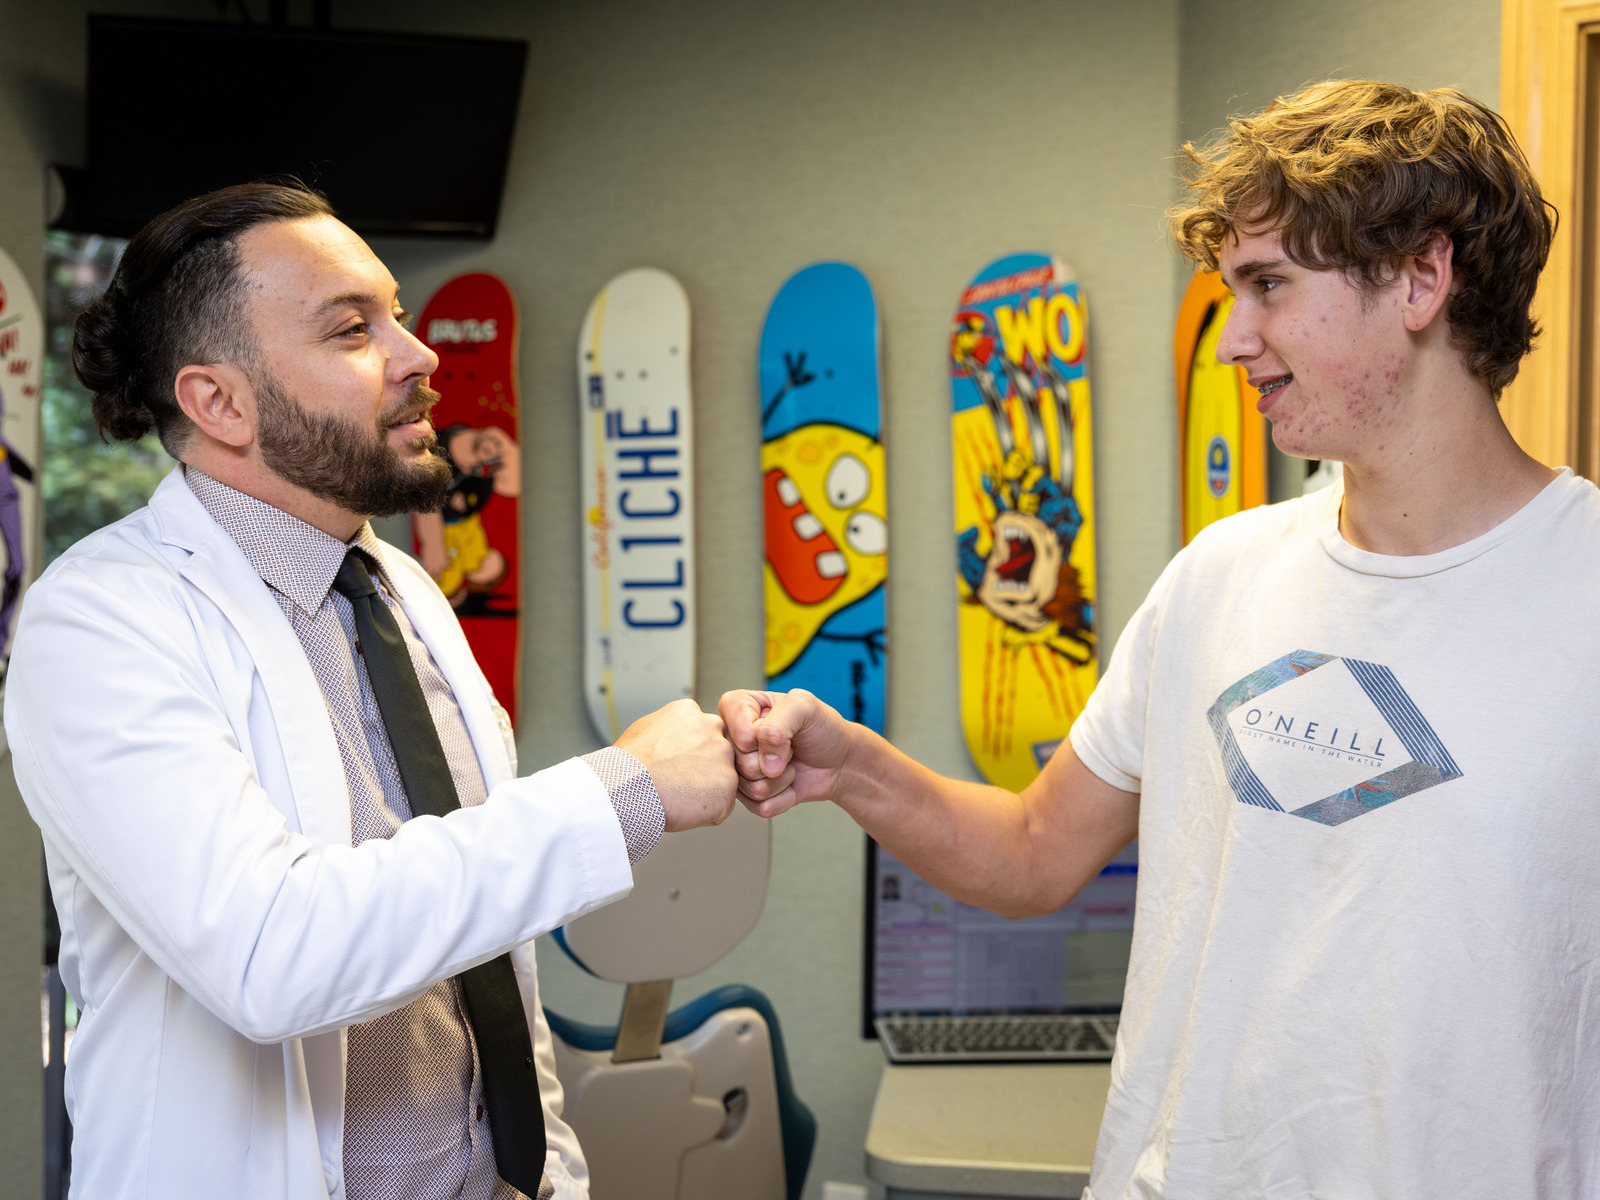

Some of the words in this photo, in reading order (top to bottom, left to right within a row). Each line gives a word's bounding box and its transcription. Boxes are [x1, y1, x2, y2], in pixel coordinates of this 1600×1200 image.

[1239, 728, 1263, 738] FIRST
[1268, 736, 1297, 747] NAME
[1302, 744, 1315, 752] IN
[1321, 748, 1341, 759] THE
[1347, 755, 1382, 768] WATER
[1245, 708, 1385, 757] O'NEILL
